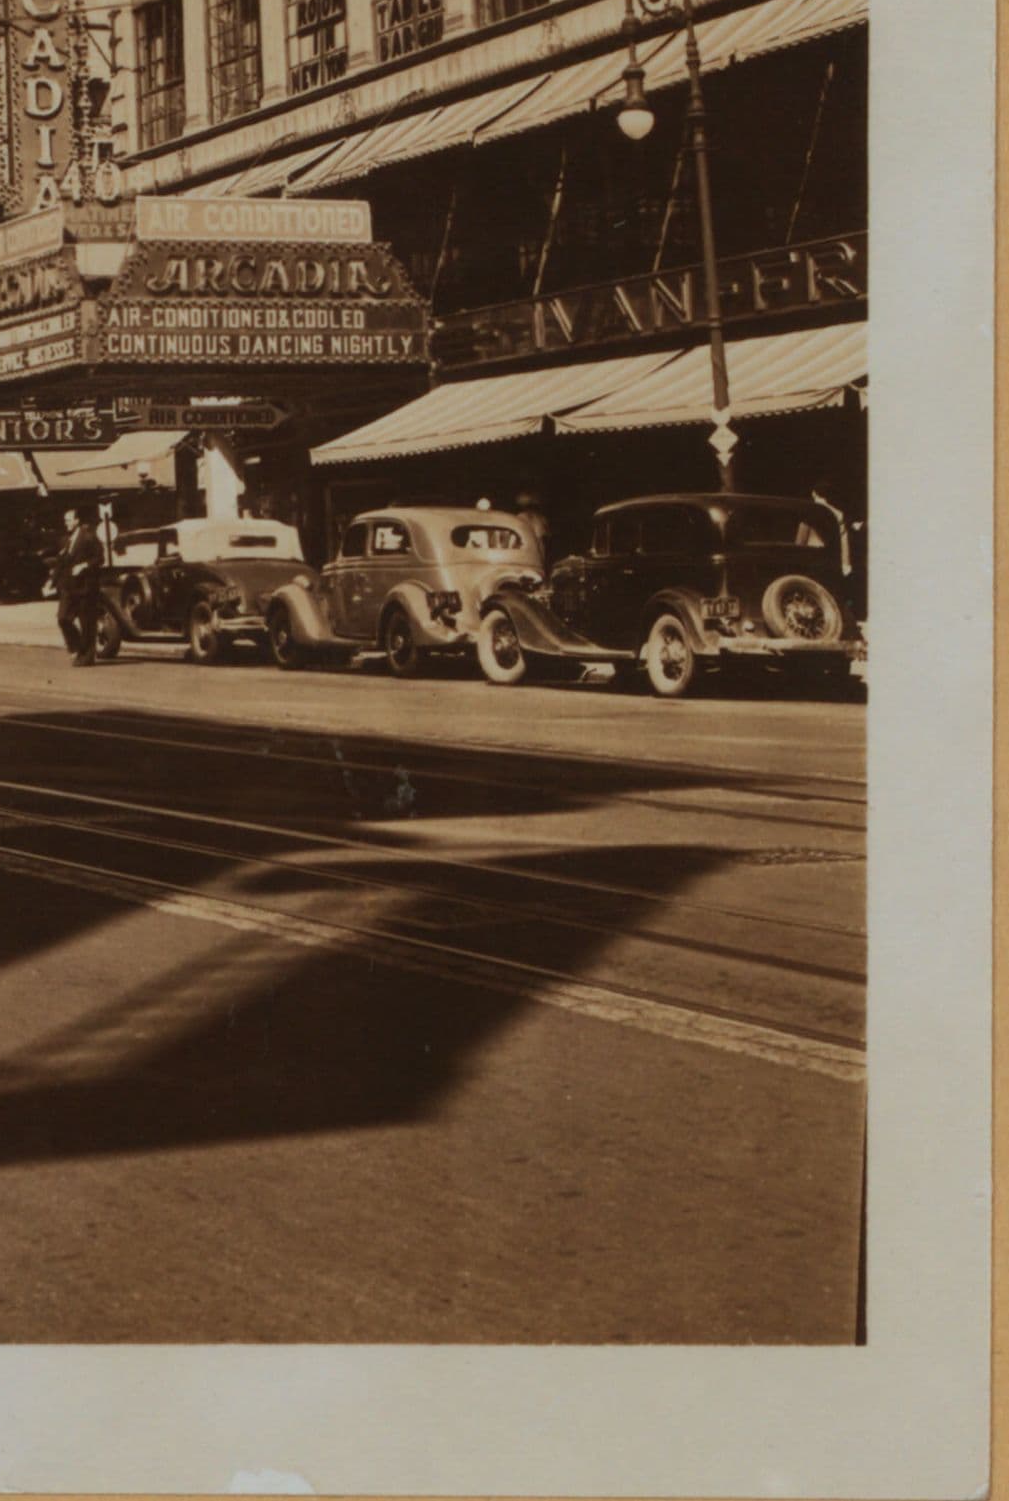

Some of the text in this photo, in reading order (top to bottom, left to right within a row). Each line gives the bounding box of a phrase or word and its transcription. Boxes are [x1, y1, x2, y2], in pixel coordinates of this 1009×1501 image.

[148, 204, 363, 233] AIR CONDITIONED
[145, 256, 392, 293] ARCADIA
[107, 334, 231, 355] CONTINUOUS
[239, 334, 324, 355] DANCING
[330, 334, 414, 355] NIGHTLY
